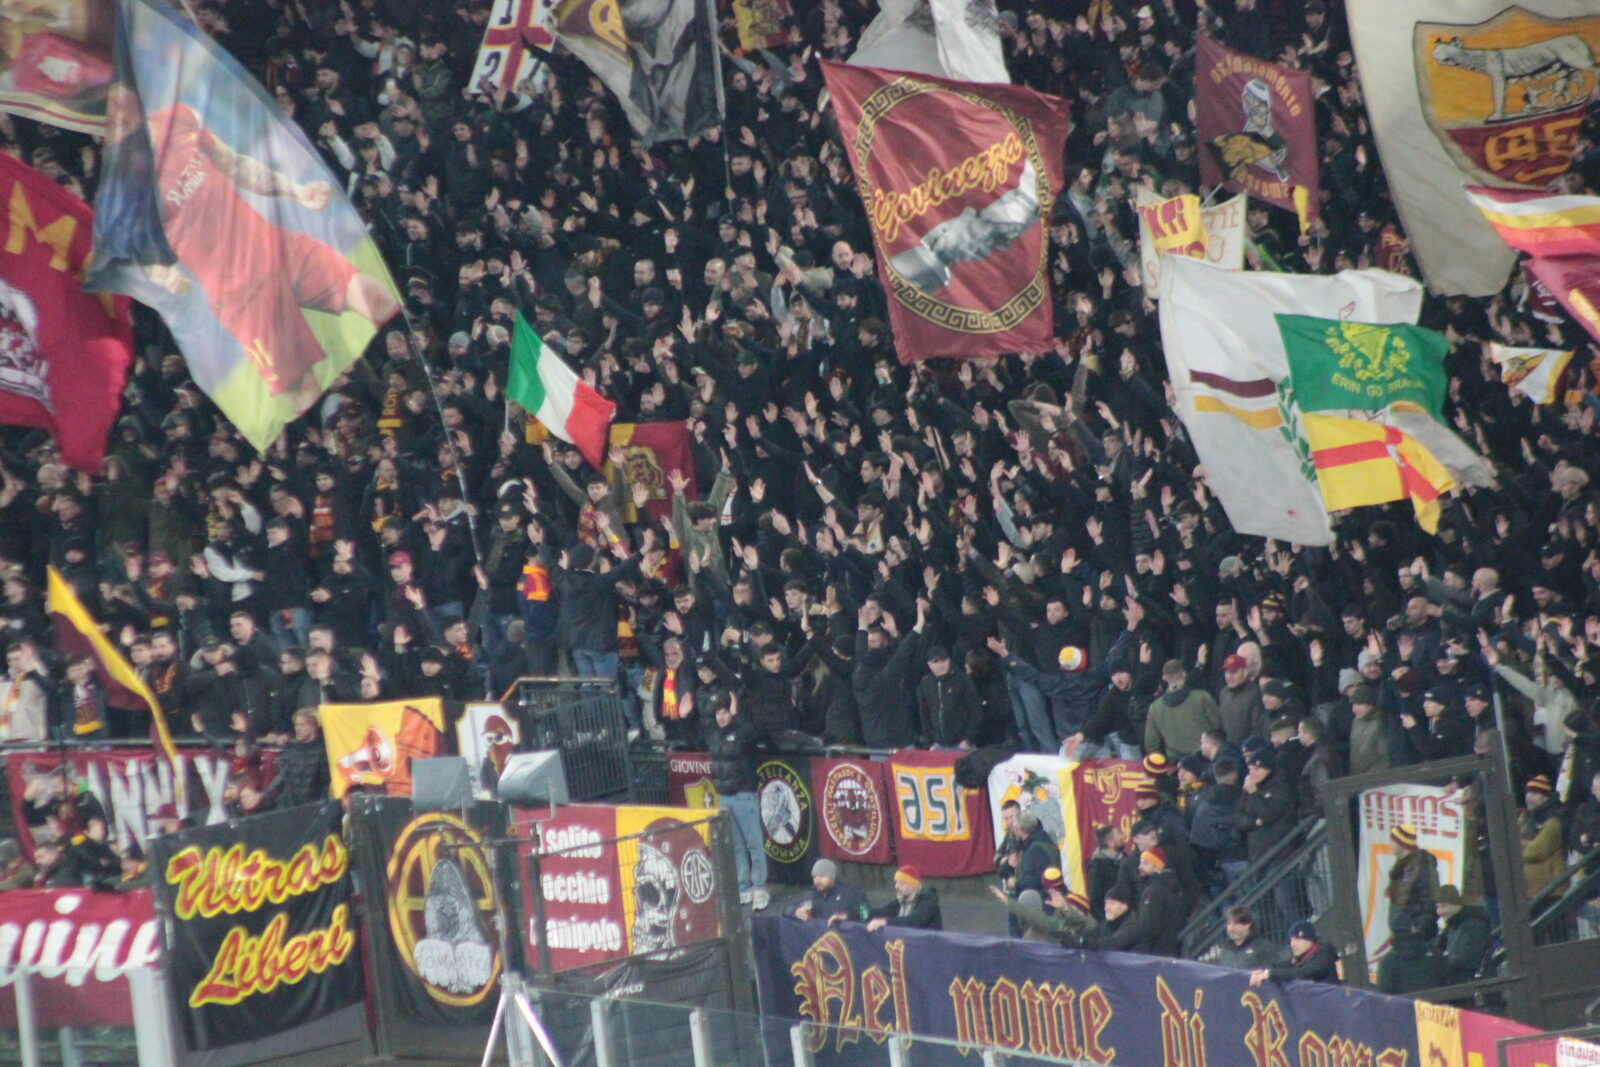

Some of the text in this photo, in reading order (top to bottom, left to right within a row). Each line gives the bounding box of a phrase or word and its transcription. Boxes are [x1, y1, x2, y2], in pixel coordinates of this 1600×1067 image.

[757, 766, 808, 811] TELLANZA
[545, 825, 602, 859] solito
[166, 835, 348, 919] Ultras
[541, 872, 610, 905] ecchio
[189, 903, 355, 1008] Liberi
[791, 931, 1407, 1067] Nel nome di Ro
